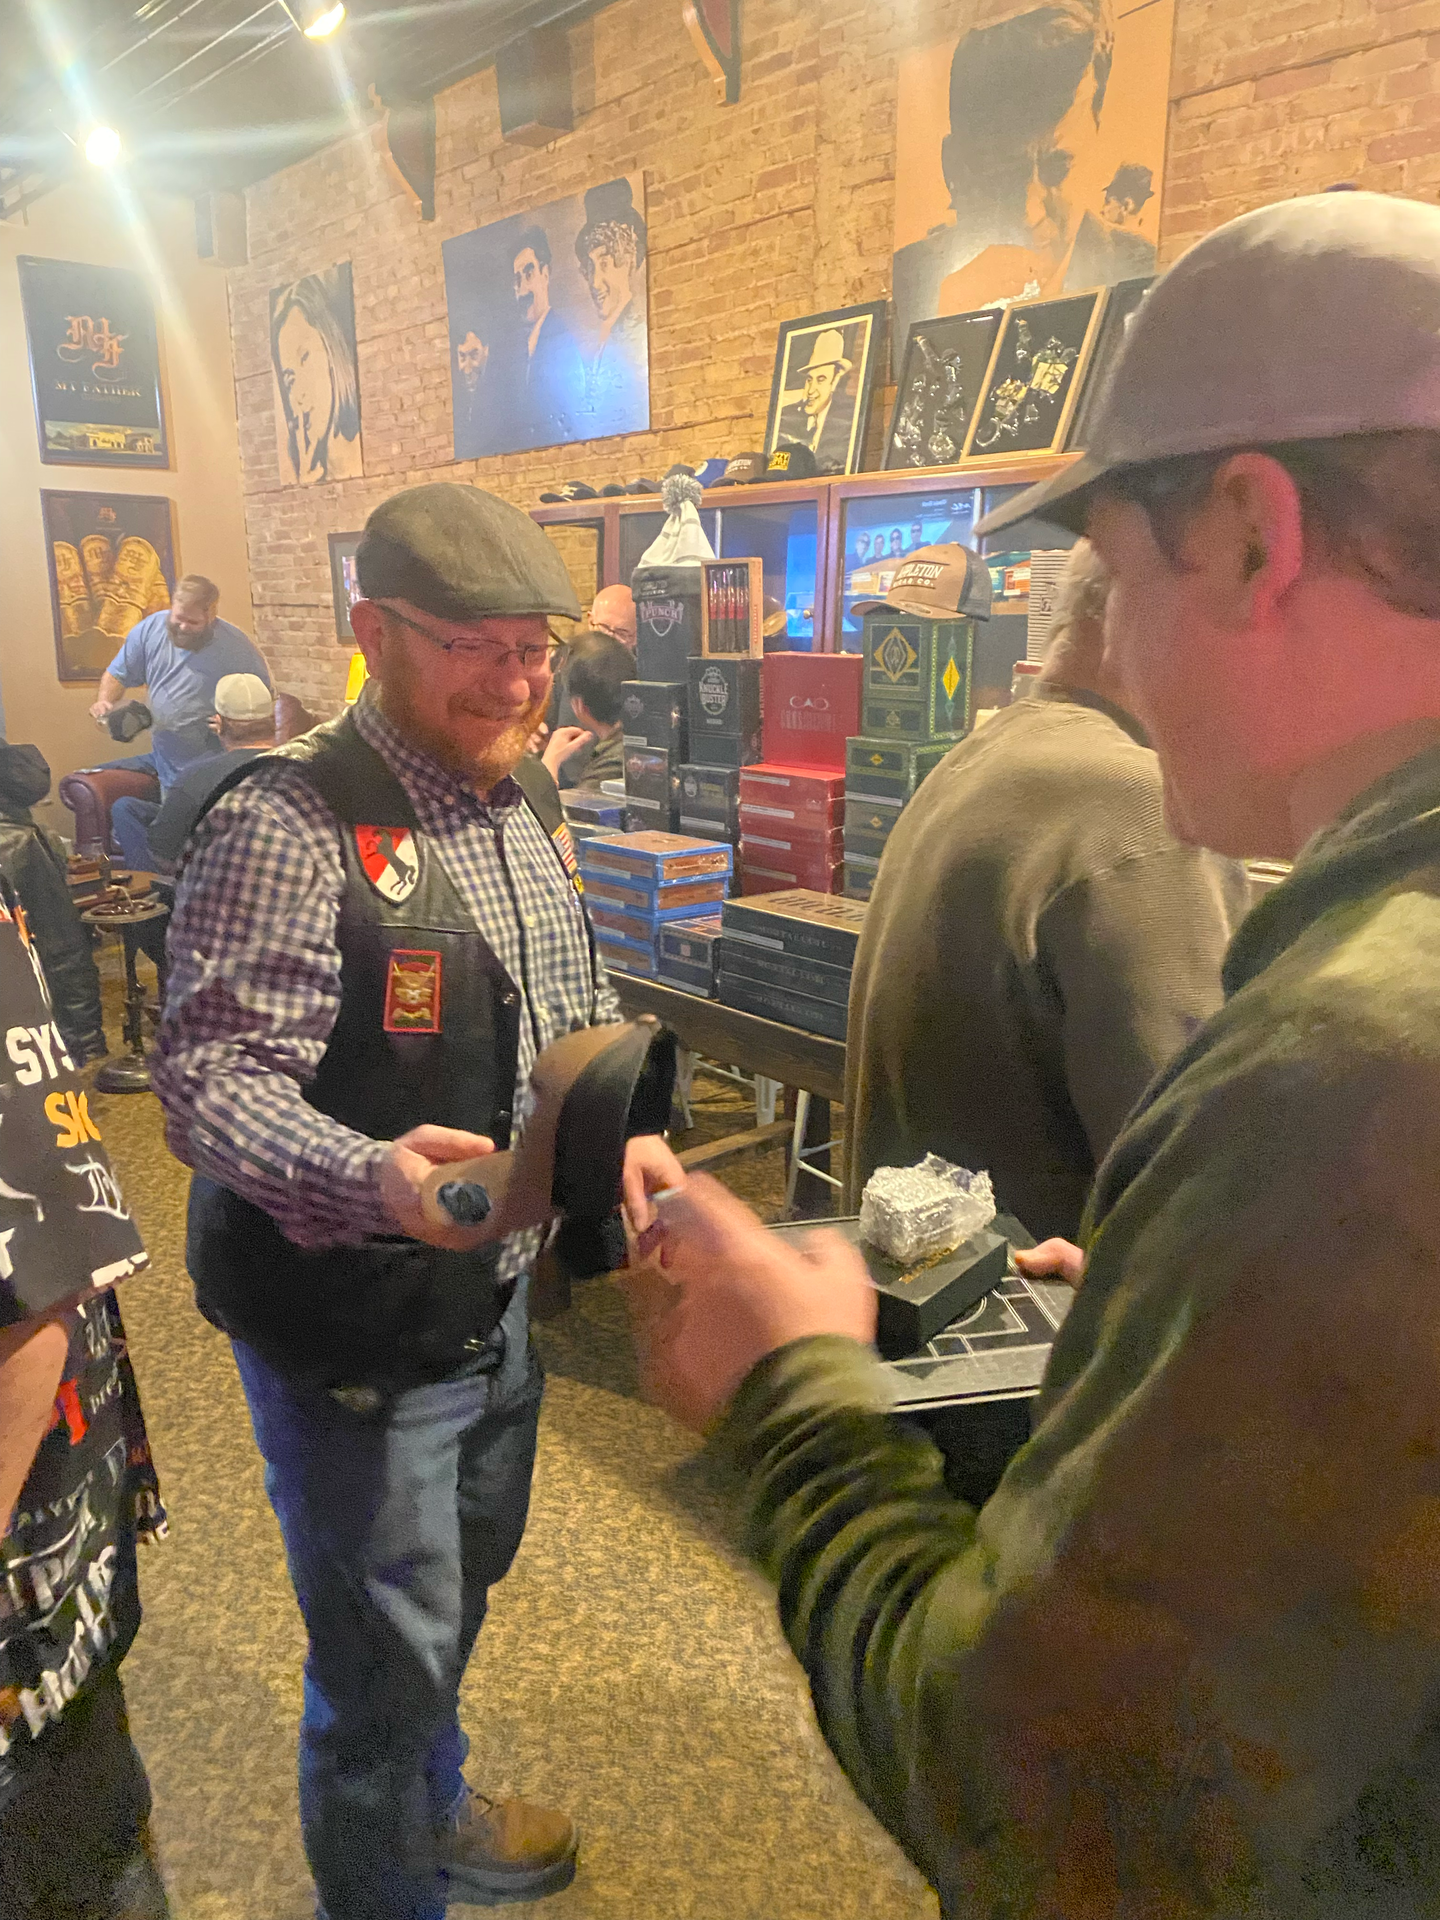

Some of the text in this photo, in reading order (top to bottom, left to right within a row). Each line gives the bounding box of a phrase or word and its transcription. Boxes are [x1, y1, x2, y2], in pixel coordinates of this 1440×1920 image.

[645, 607, 678, 618] PUNCH
[699, 682, 728, 695] KNUCKLE
[789, 696, 829, 711] CAO
